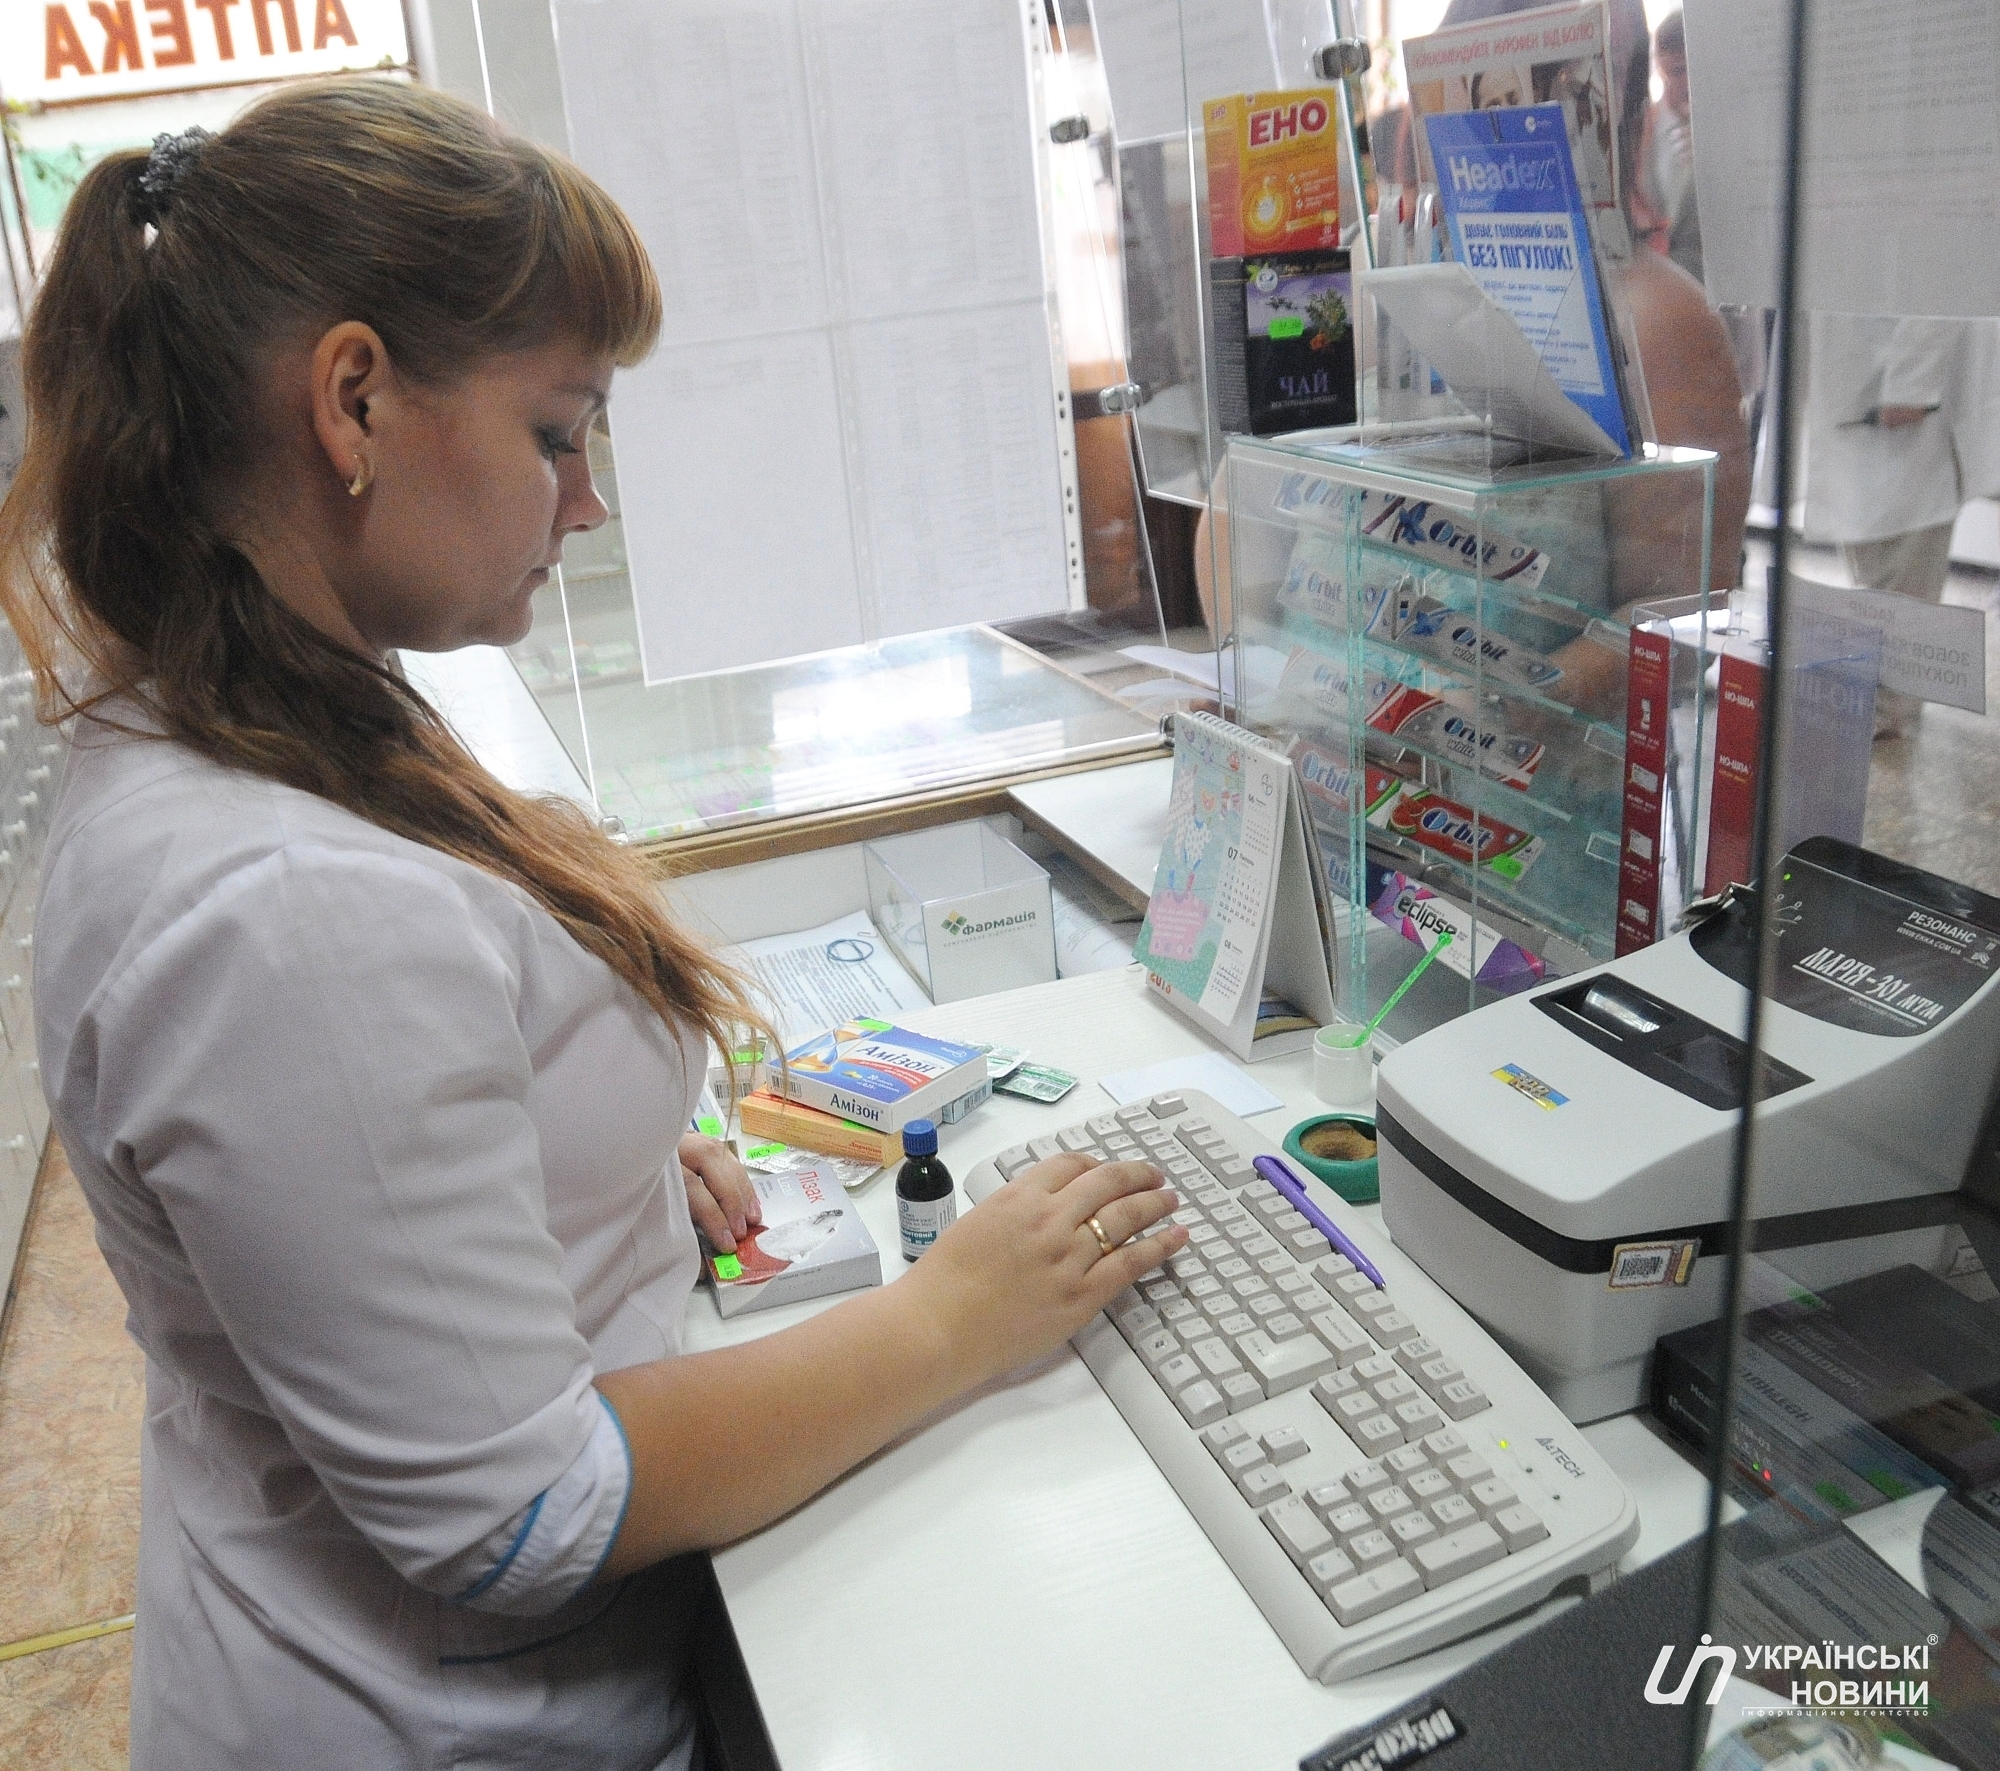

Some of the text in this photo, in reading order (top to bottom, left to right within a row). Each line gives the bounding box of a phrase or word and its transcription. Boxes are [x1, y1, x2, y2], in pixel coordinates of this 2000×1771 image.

[1250, 100, 1327, 147] ЕНО
[1450, 153, 1555, 192] Headex
[1468, 243, 1573, 270] БЕЗ ПІГУЛОК!
[1279, 368, 1328, 398] ЧАЙ
[1429, 519, 1498, 564] Orbit
[1452, 626, 1508, 661] Orbit
[1725, 690, 1755, 709] НО-ШПА
[1444, 717, 1497, 750] Orbit
[1719, 754, 1749, 774] НО-ШПА
[1422, 808, 1493, 849] Orbit
[1228, 846, 1238, 860] 07
[962, 910, 1036, 936] фармація
[1397, 894, 1458, 936] eclipse
[1908, 911, 1977, 944] РЕЗОНАНС
[1800, 946, 1911, 1001] МАРІЯ-301
[830, 1093, 879, 1121] Амізон
[795, 1170, 825, 1203] Лізак
